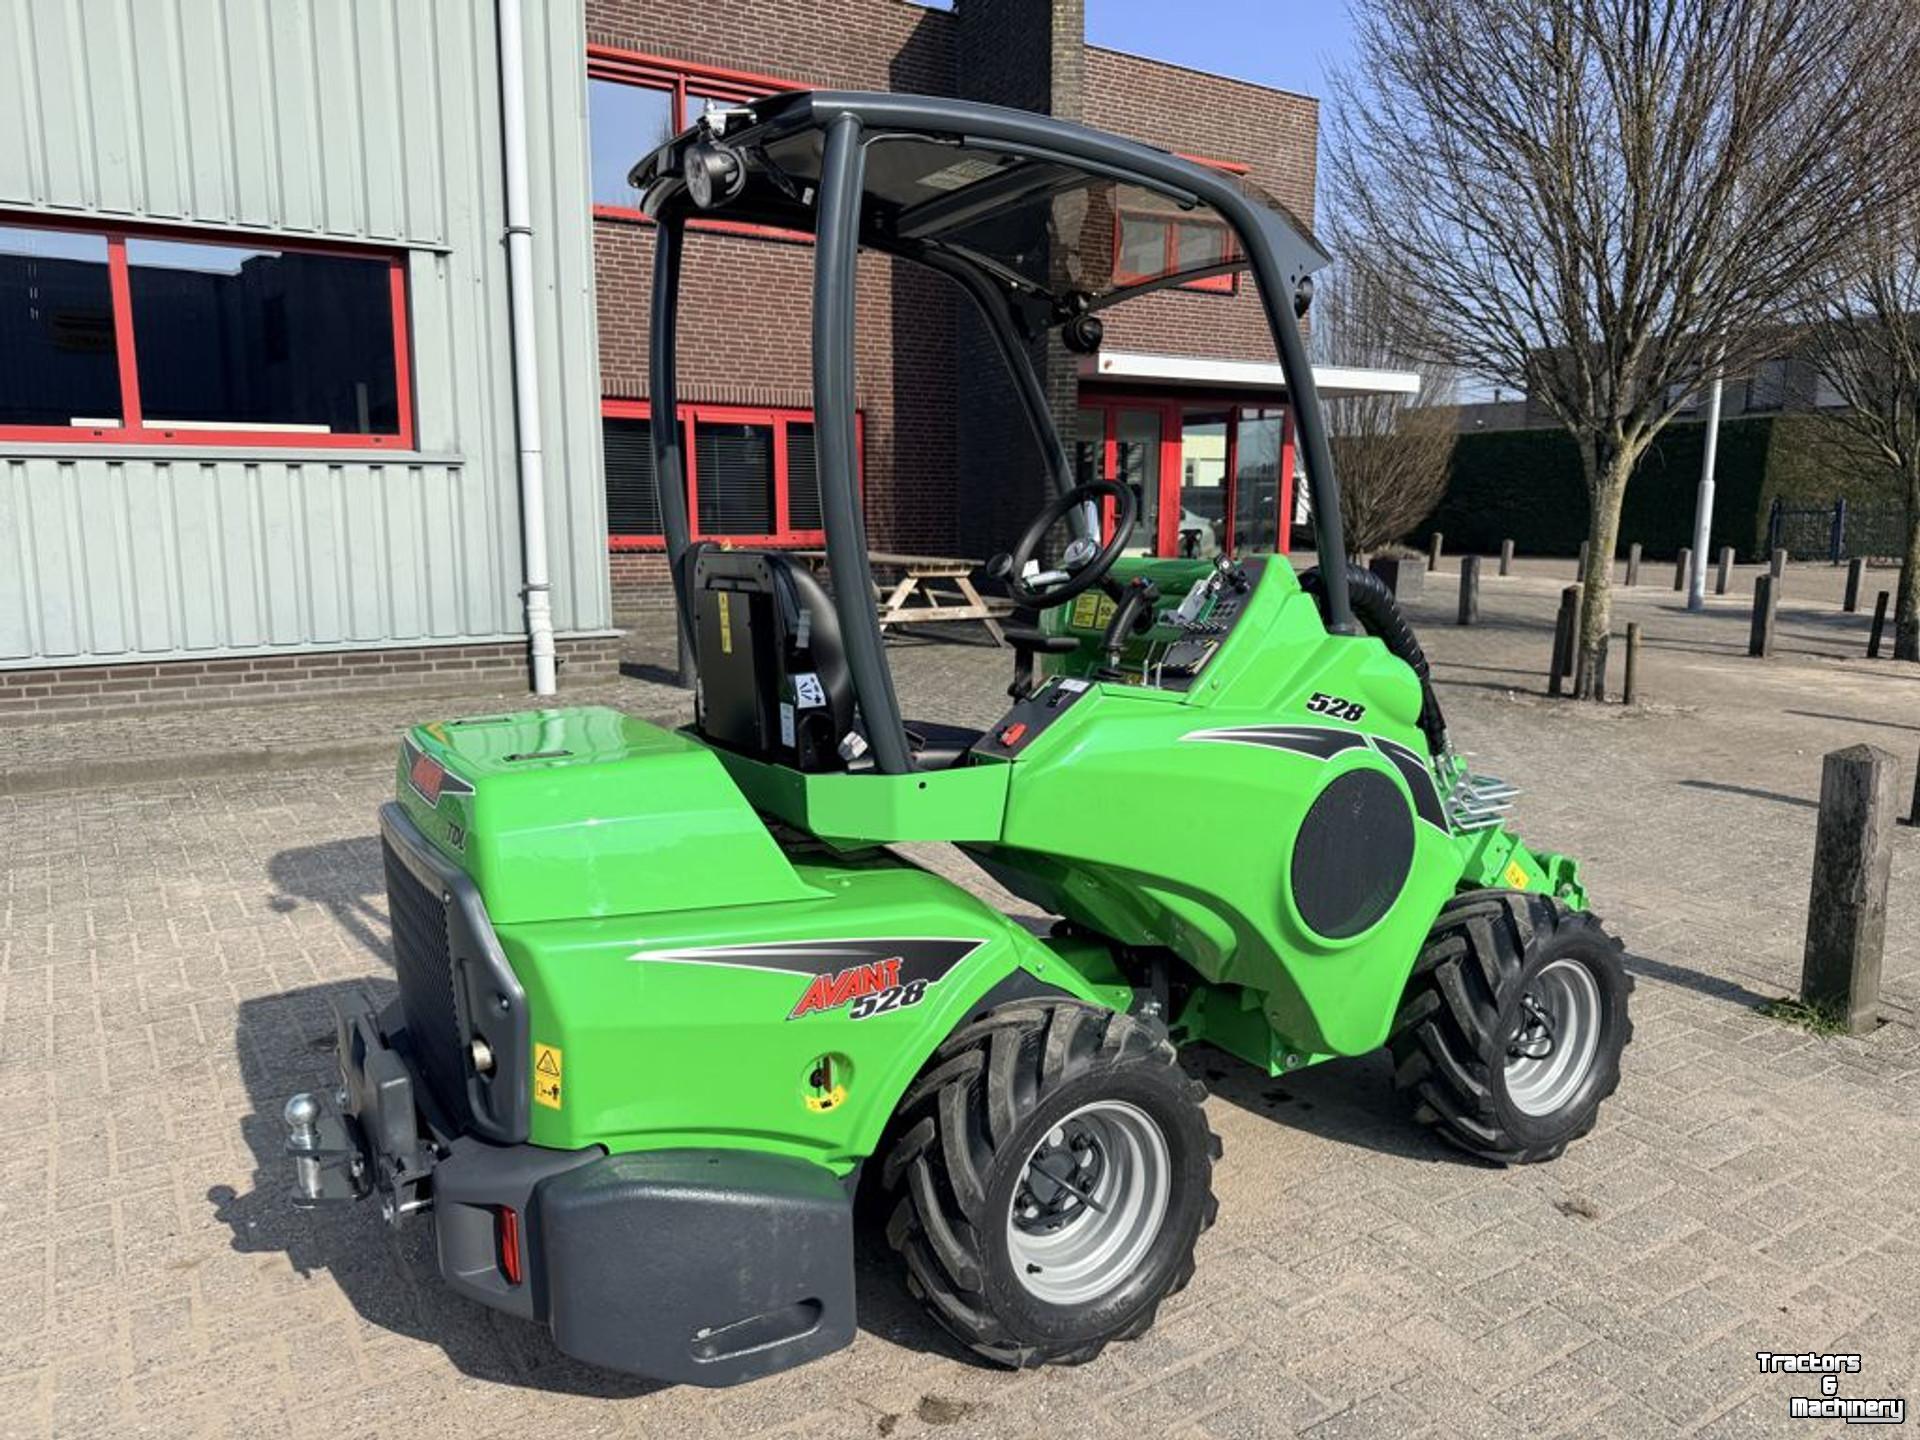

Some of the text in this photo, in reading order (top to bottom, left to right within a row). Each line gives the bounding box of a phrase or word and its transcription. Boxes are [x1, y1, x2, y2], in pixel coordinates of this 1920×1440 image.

[1306, 692, 1366, 722] 528
[786, 956, 904, 1020] AVANT
[850, 979, 928, 1020] 528
